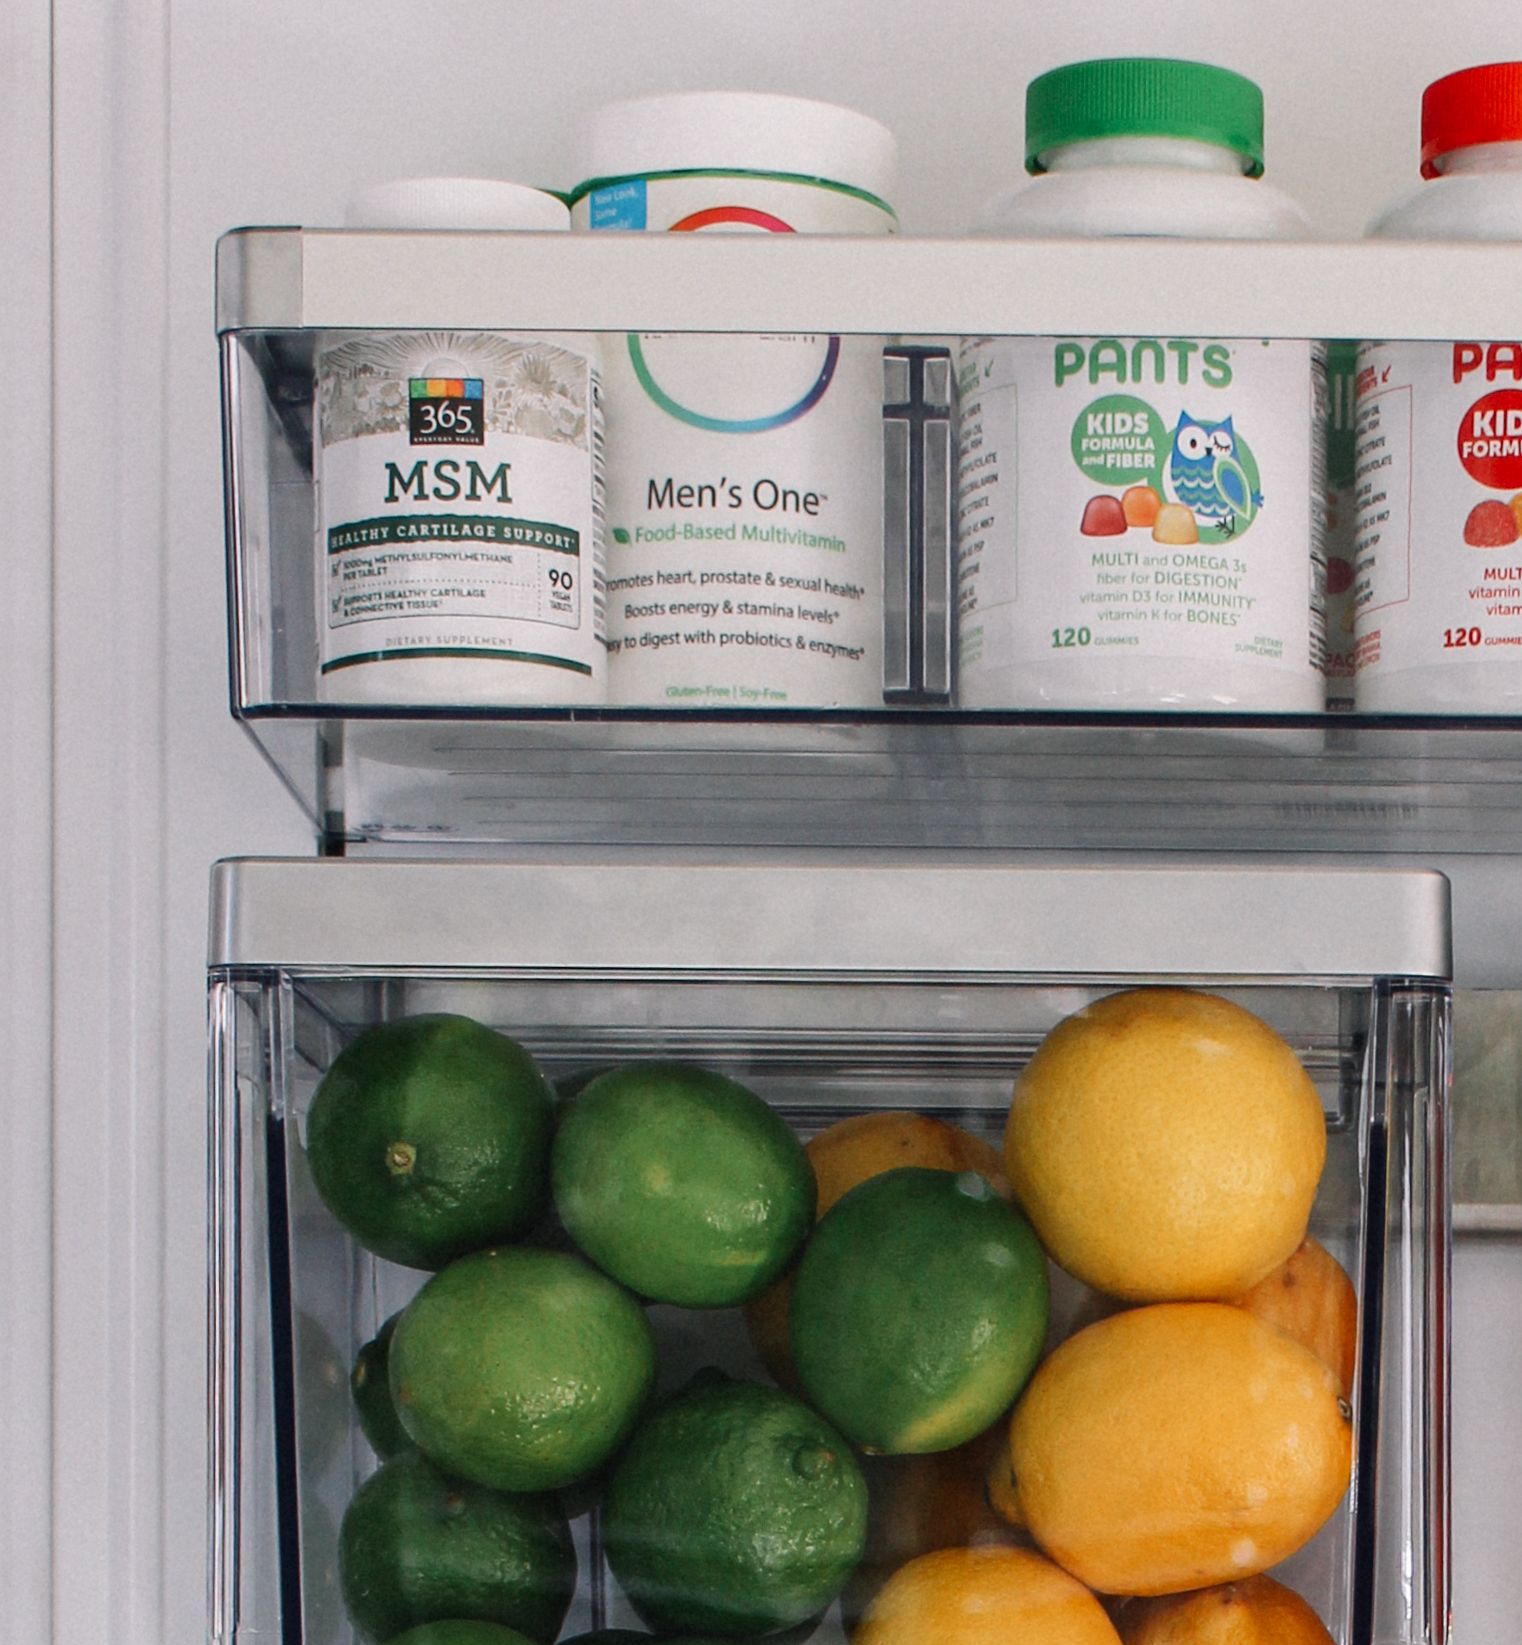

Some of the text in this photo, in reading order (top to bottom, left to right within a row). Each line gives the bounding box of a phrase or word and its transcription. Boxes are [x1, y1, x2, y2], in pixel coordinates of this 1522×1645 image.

[1054, 339, 1233, 388] PANTS
[420, 402, 472, 433] 365
[1087, 413, 1149, 436] KIDS
[1081, 437, 1155, 451] FORMULA
[1106, 453, 1155, 469] FIBER
[384, 460, 512, 503] MSM
[647, 477, 742, 510] Men's
[331, 524, 496, 548] HEALTHY CARTILAGE
[741, 524, 845, 552] Multivitamin
[549, 569, 572, 590] 90
[700, 571, 821, 591] prostate sexual
[669, 602, 793, 617] energy stamina
[720, 632, 792, 649] probiotics
[1052, 627, 1091, 648] 120
[1444, 627, 1481, 647] 120
